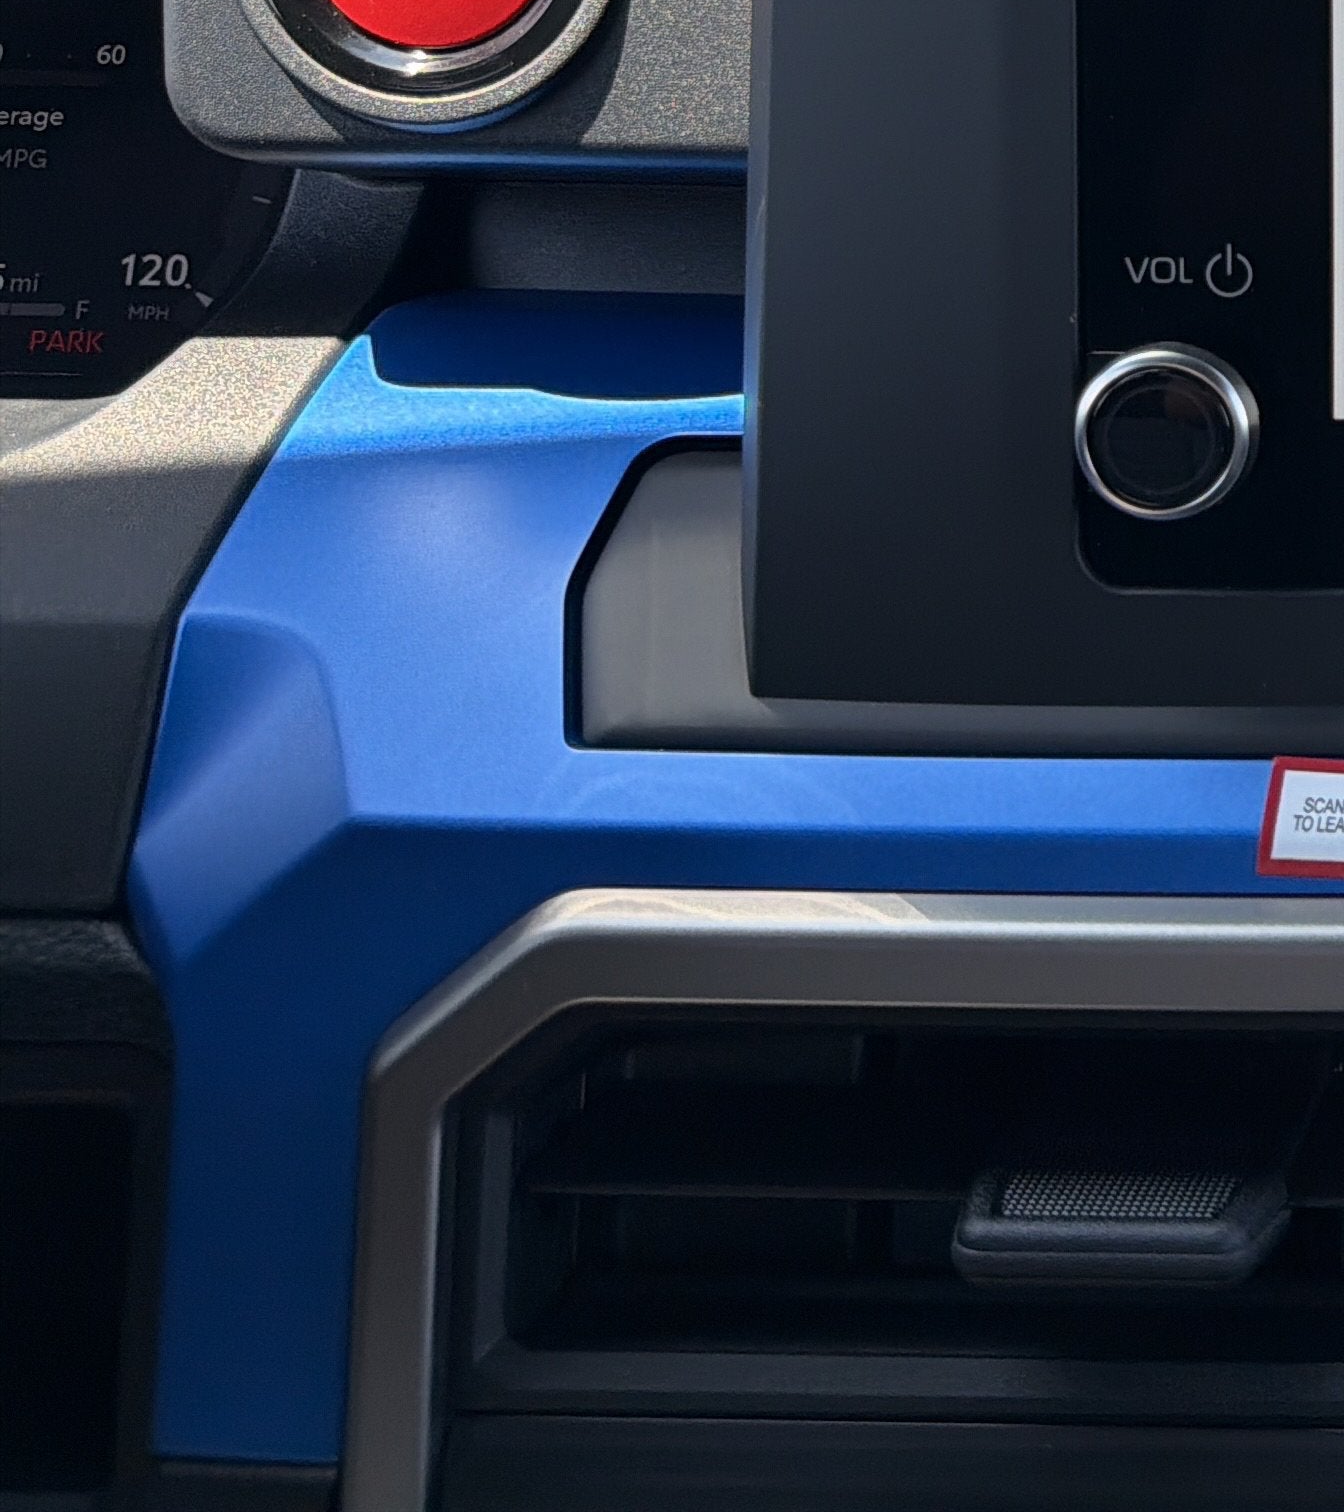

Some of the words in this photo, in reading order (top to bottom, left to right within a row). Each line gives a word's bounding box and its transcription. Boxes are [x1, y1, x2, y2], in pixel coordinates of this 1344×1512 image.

[96, 44, 126, 65] 60
[121, 253, 189, 287] 120
[1124, 256, 1194, 284] VOL
[75, 300, 90, 320] F
[128, 304, 170, 321] MPH
[30, 330, 104, 354] PARK
[1293, 814, 1314, 833] TO
